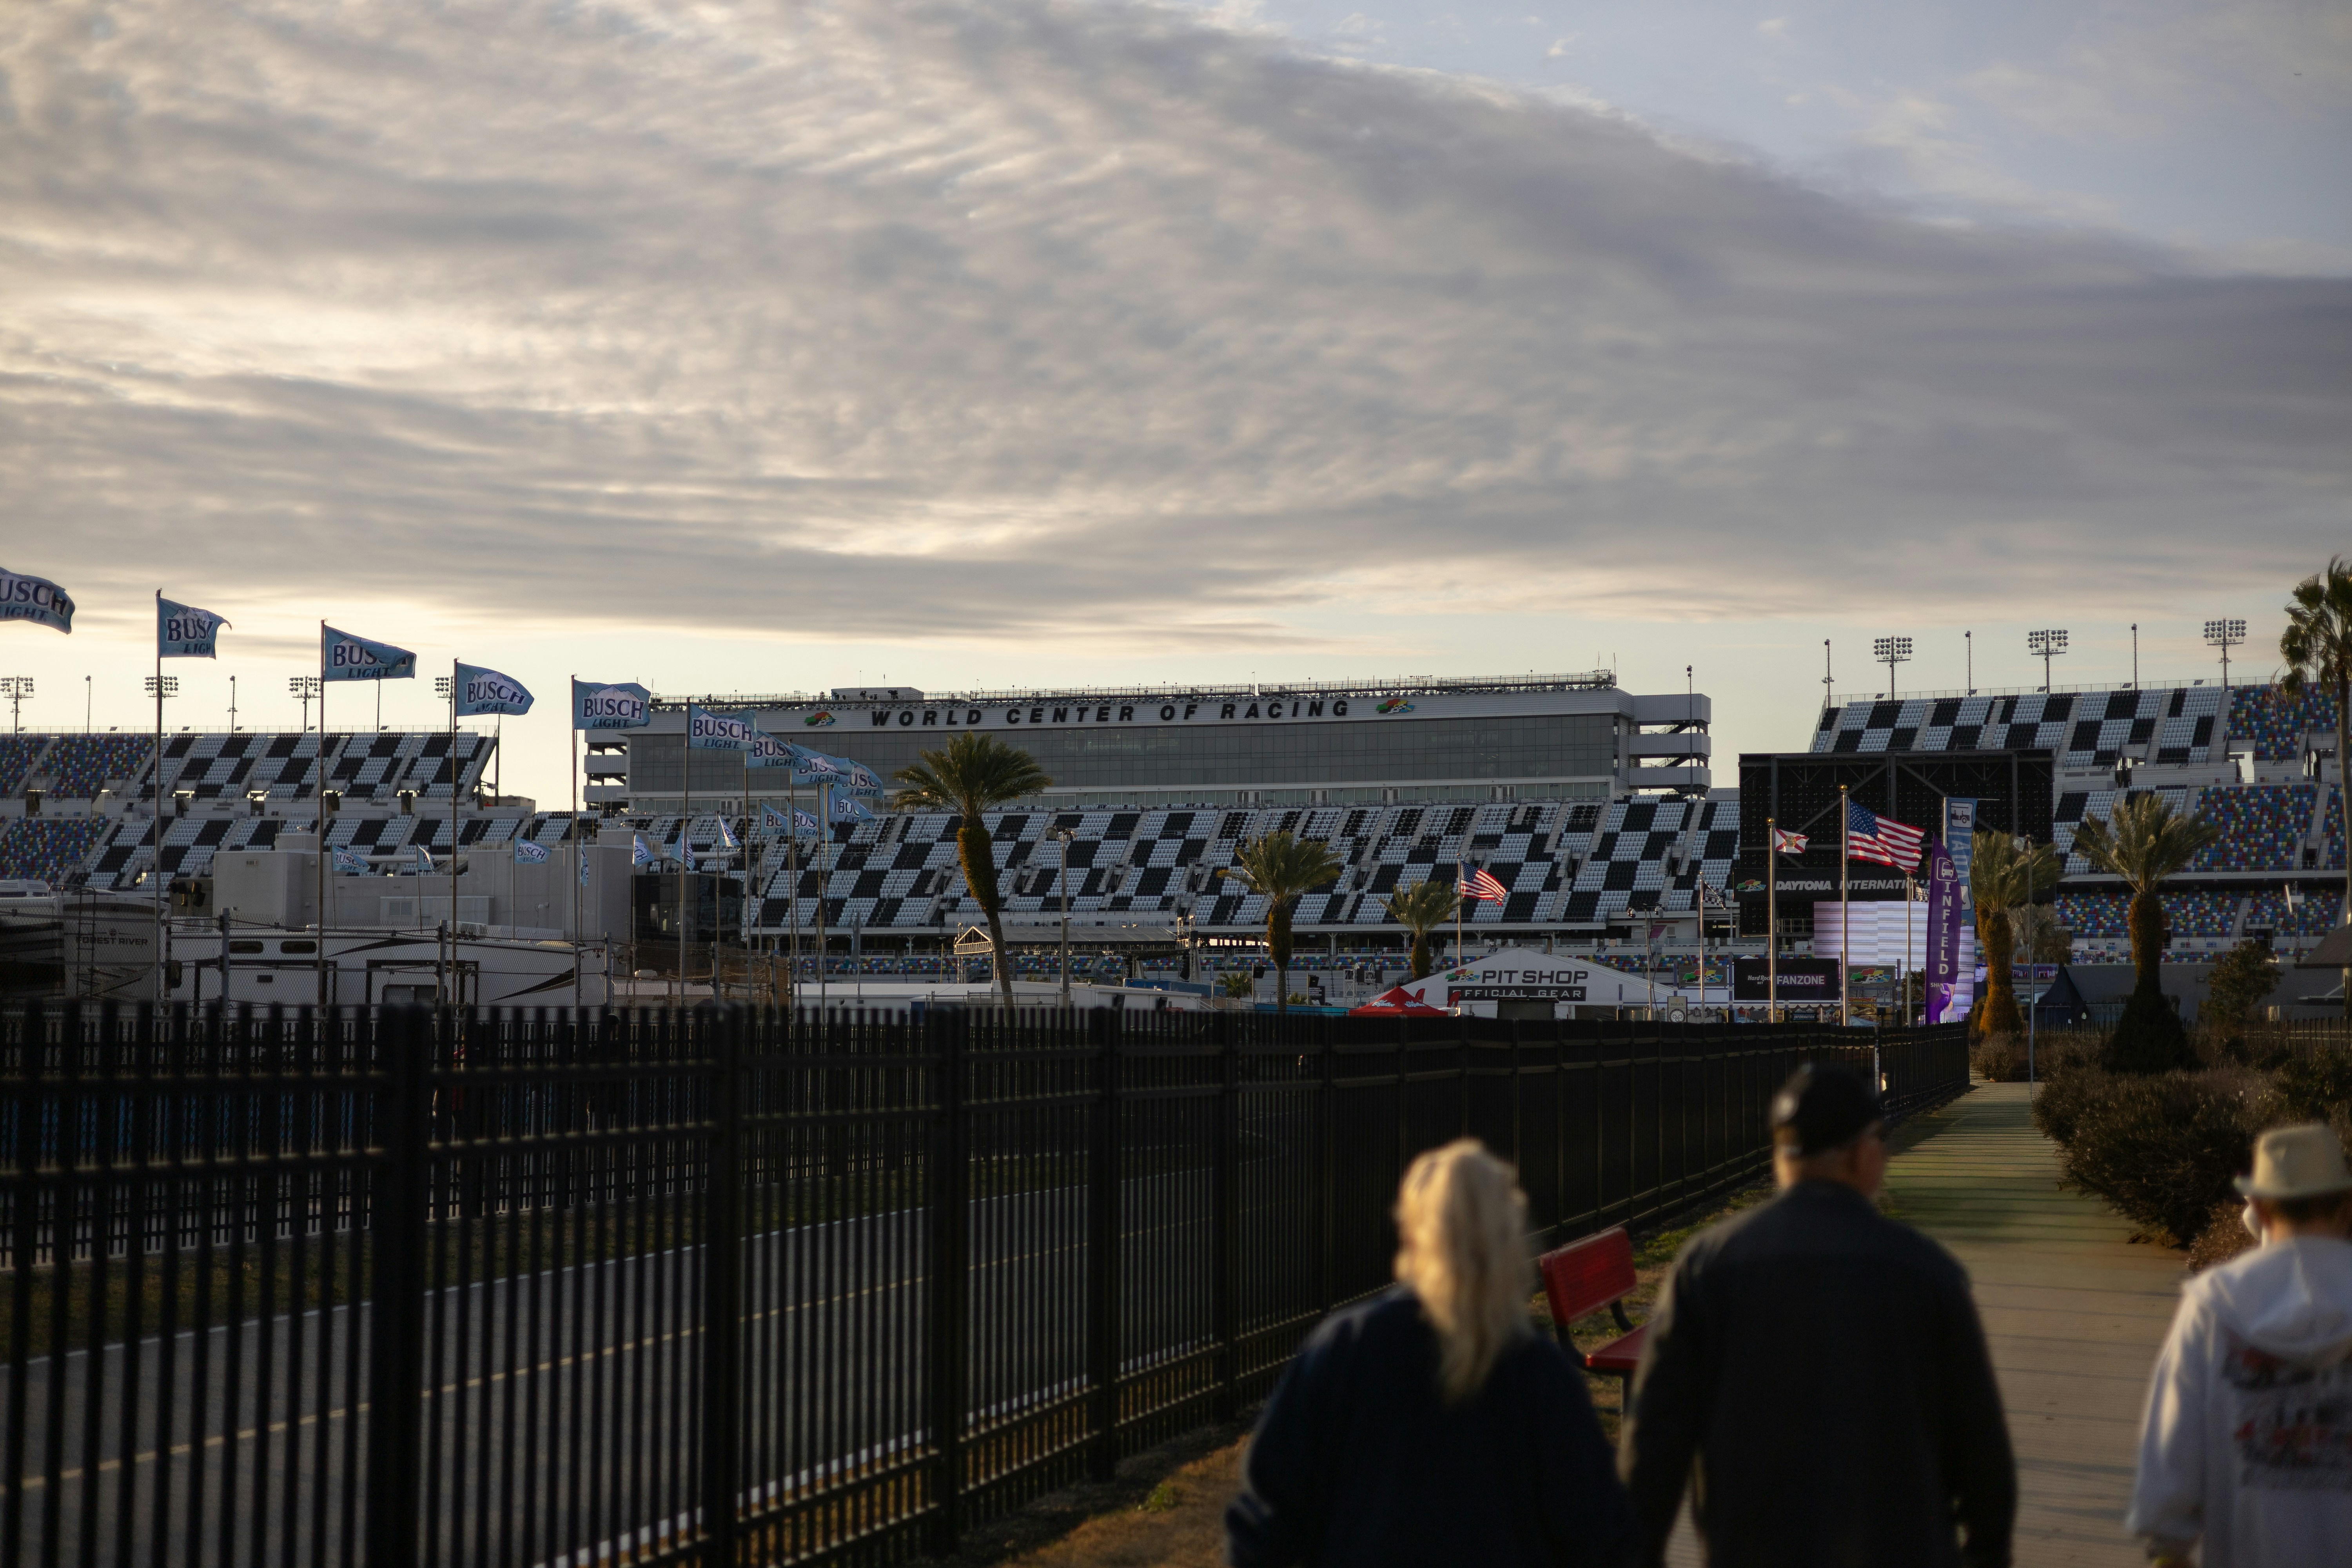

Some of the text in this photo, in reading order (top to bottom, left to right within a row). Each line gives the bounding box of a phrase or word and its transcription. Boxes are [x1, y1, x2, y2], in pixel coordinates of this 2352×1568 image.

[0, 579, 67, 616] USCH
[0, 606, 49, 621] IGHT
[184, 643, 211, 654] LIGH
[467, 681, 526, 704] BUSCH
[583, 698, 645, 719] BUSCH
[871, 700, 1348, 726] WORLD CENTER OF RACING
[592, 719, 629, 728] LIGHT
[692, 719, 752, 742] BUSCH
[704, 739, 740, 749] LIGHT
[518, 846, 546, 860] BUSCH
[1775, 880, 1832, 891] DAYTONA
[1938, 882, 1952, 974] INFIELD
[1482, 970, 1588, 984] PIT SHOP
[1777, 975, 1825, 985] FANZONE
